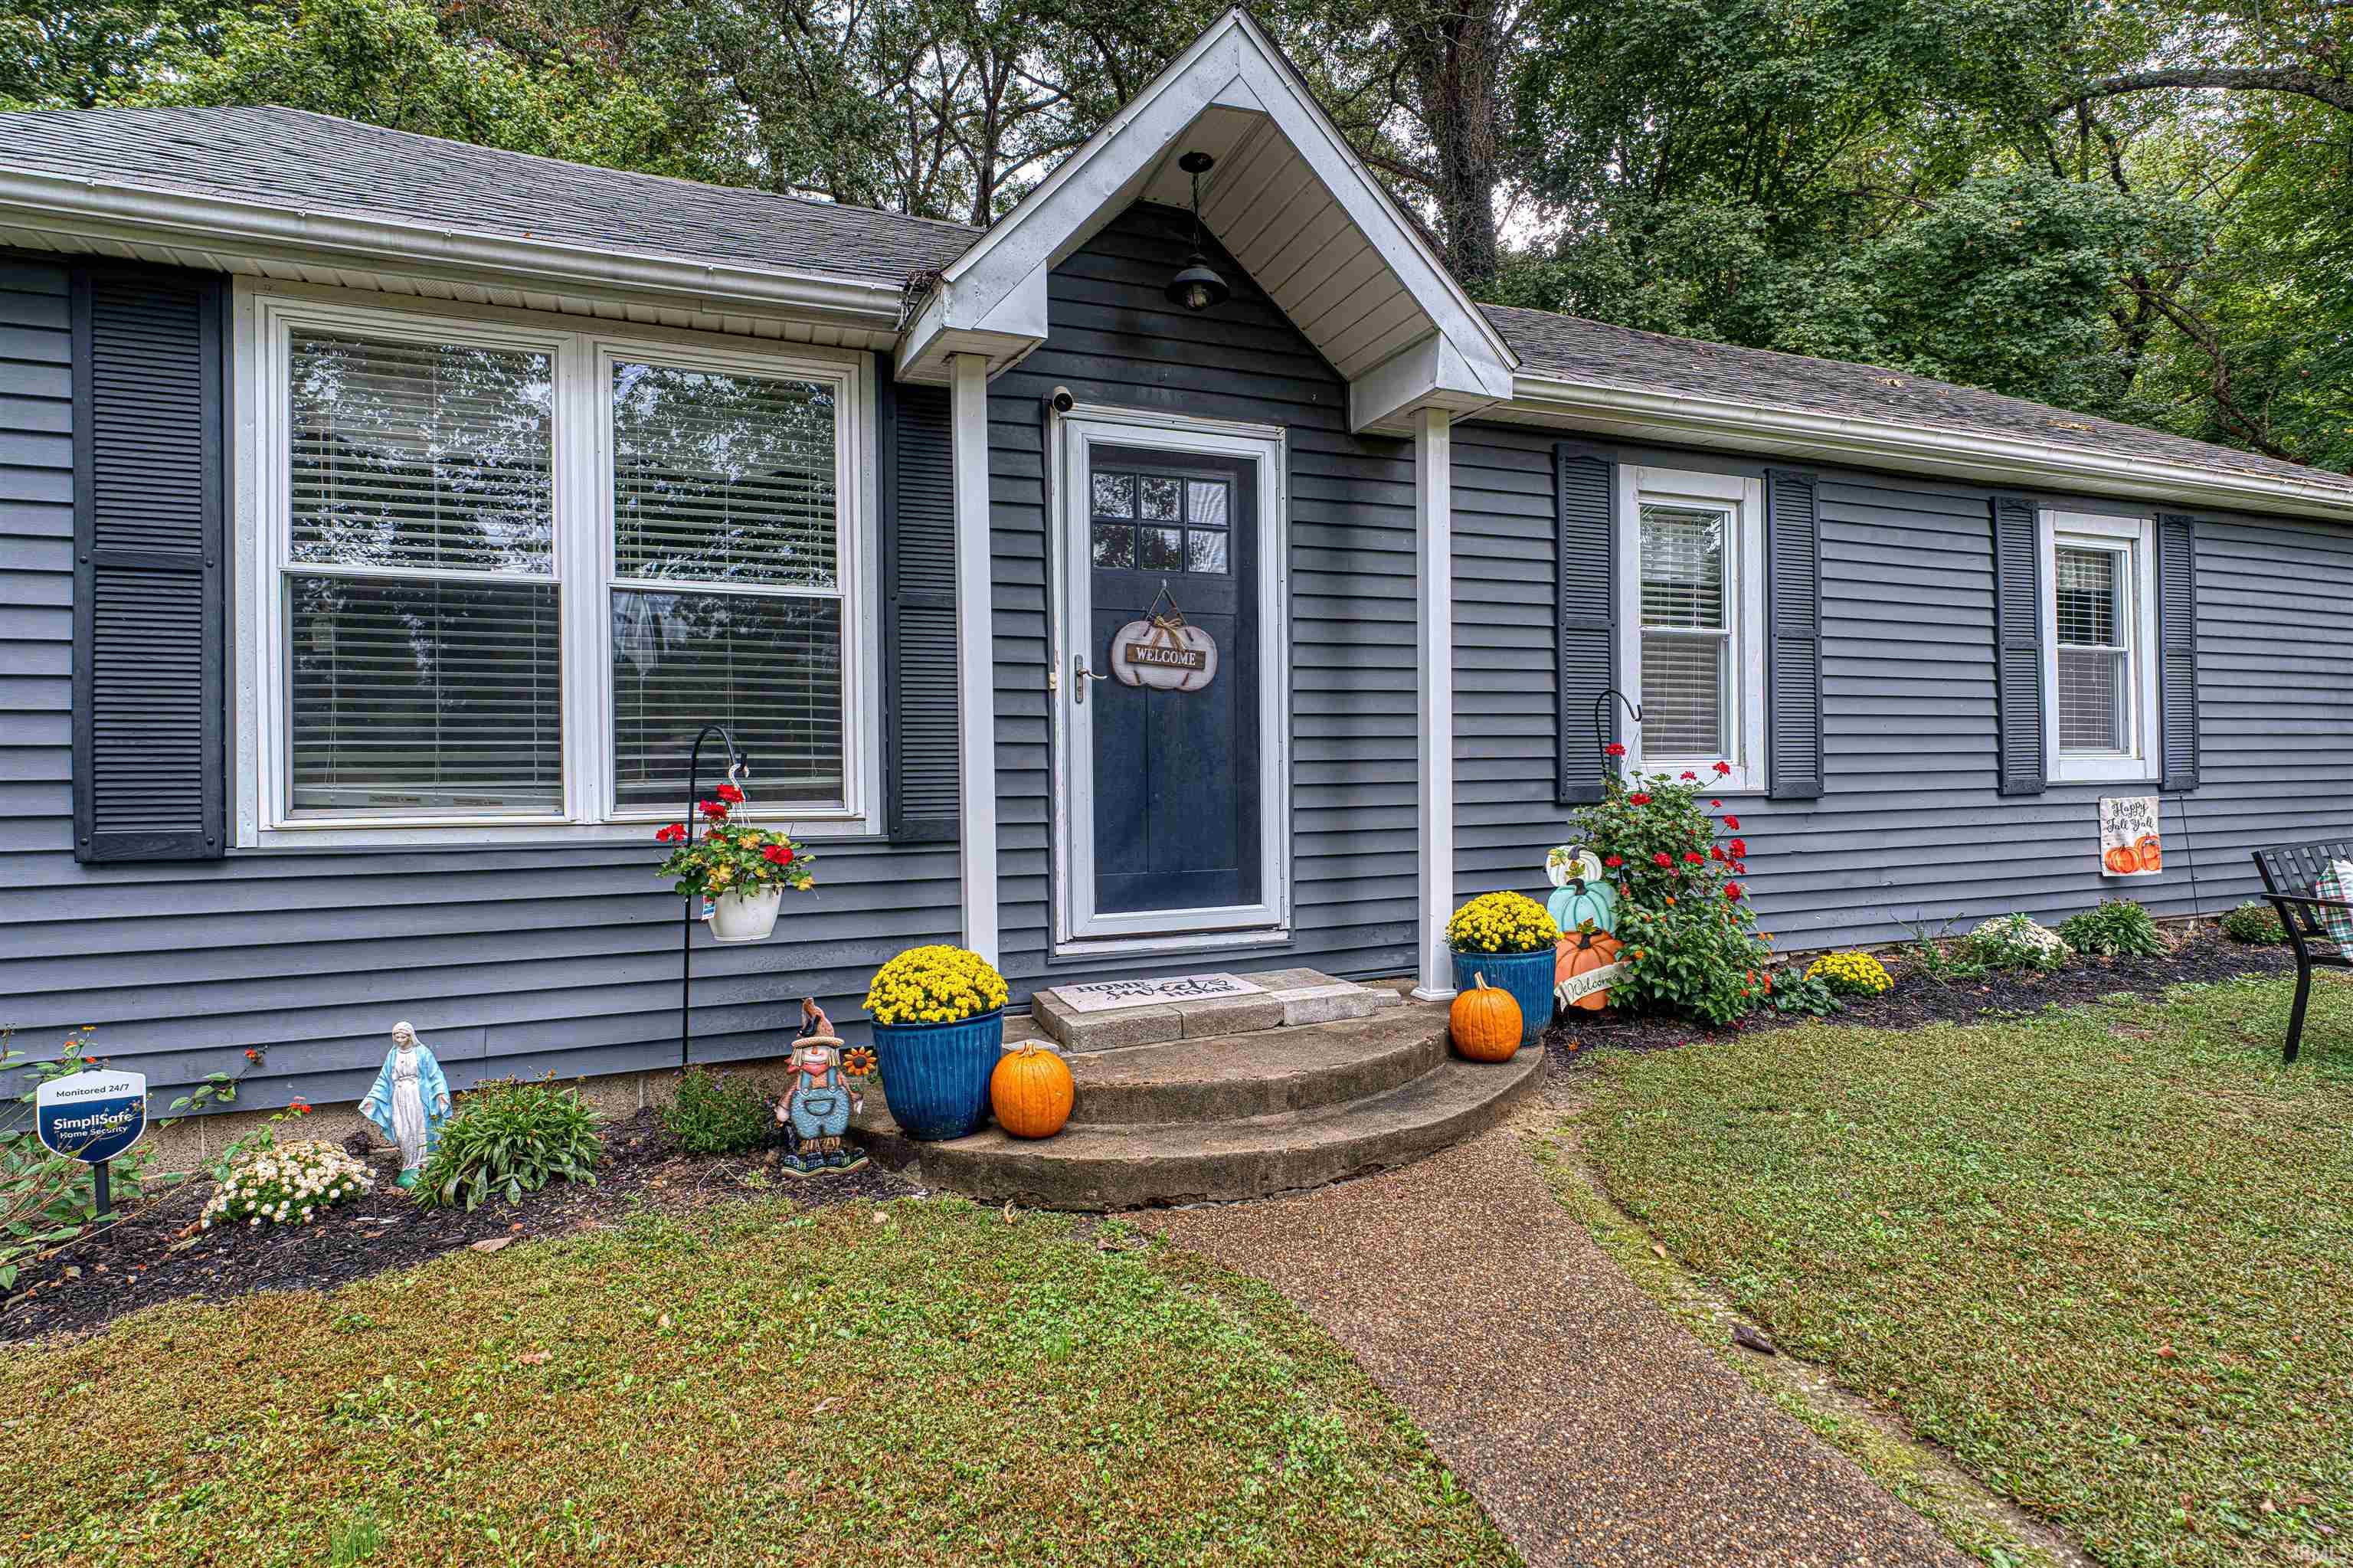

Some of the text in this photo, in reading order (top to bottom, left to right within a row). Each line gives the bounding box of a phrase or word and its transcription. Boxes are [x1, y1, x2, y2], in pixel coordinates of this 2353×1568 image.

[1136, 647, 1196, 666] WELCOME
[2112, 802, 2148, 817] Happy
[2107, 817, 2129, 833] Fall
[1076, 981, 1152, 993] HOME
[1164, 985, 1242, 997] HOME
[56, 1083, 129, 1098] Monitored 24/7
[53, 1111, 133, 1131] SimpliSafe
[60, 1124, 129, 1139] Home Security
